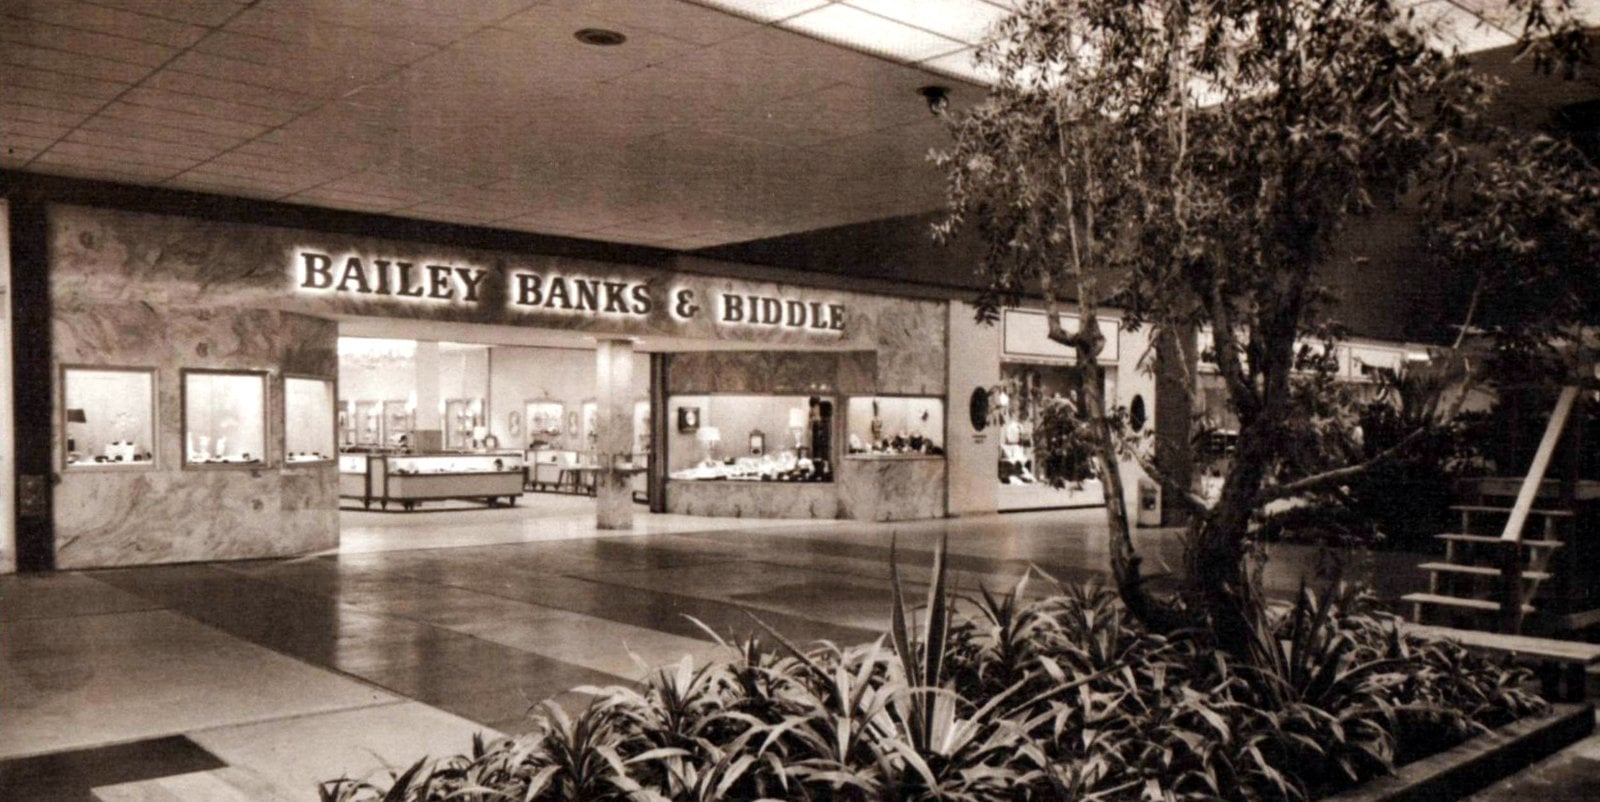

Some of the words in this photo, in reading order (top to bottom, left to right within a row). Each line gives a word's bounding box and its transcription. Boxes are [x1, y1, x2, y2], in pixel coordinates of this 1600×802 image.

[300, 252, 487, 302] BAILEY
[515, 273, 652, 314] BANKS
[676, 289, 700, 318] &
[722, 293, 846, 331] BIDDLE
